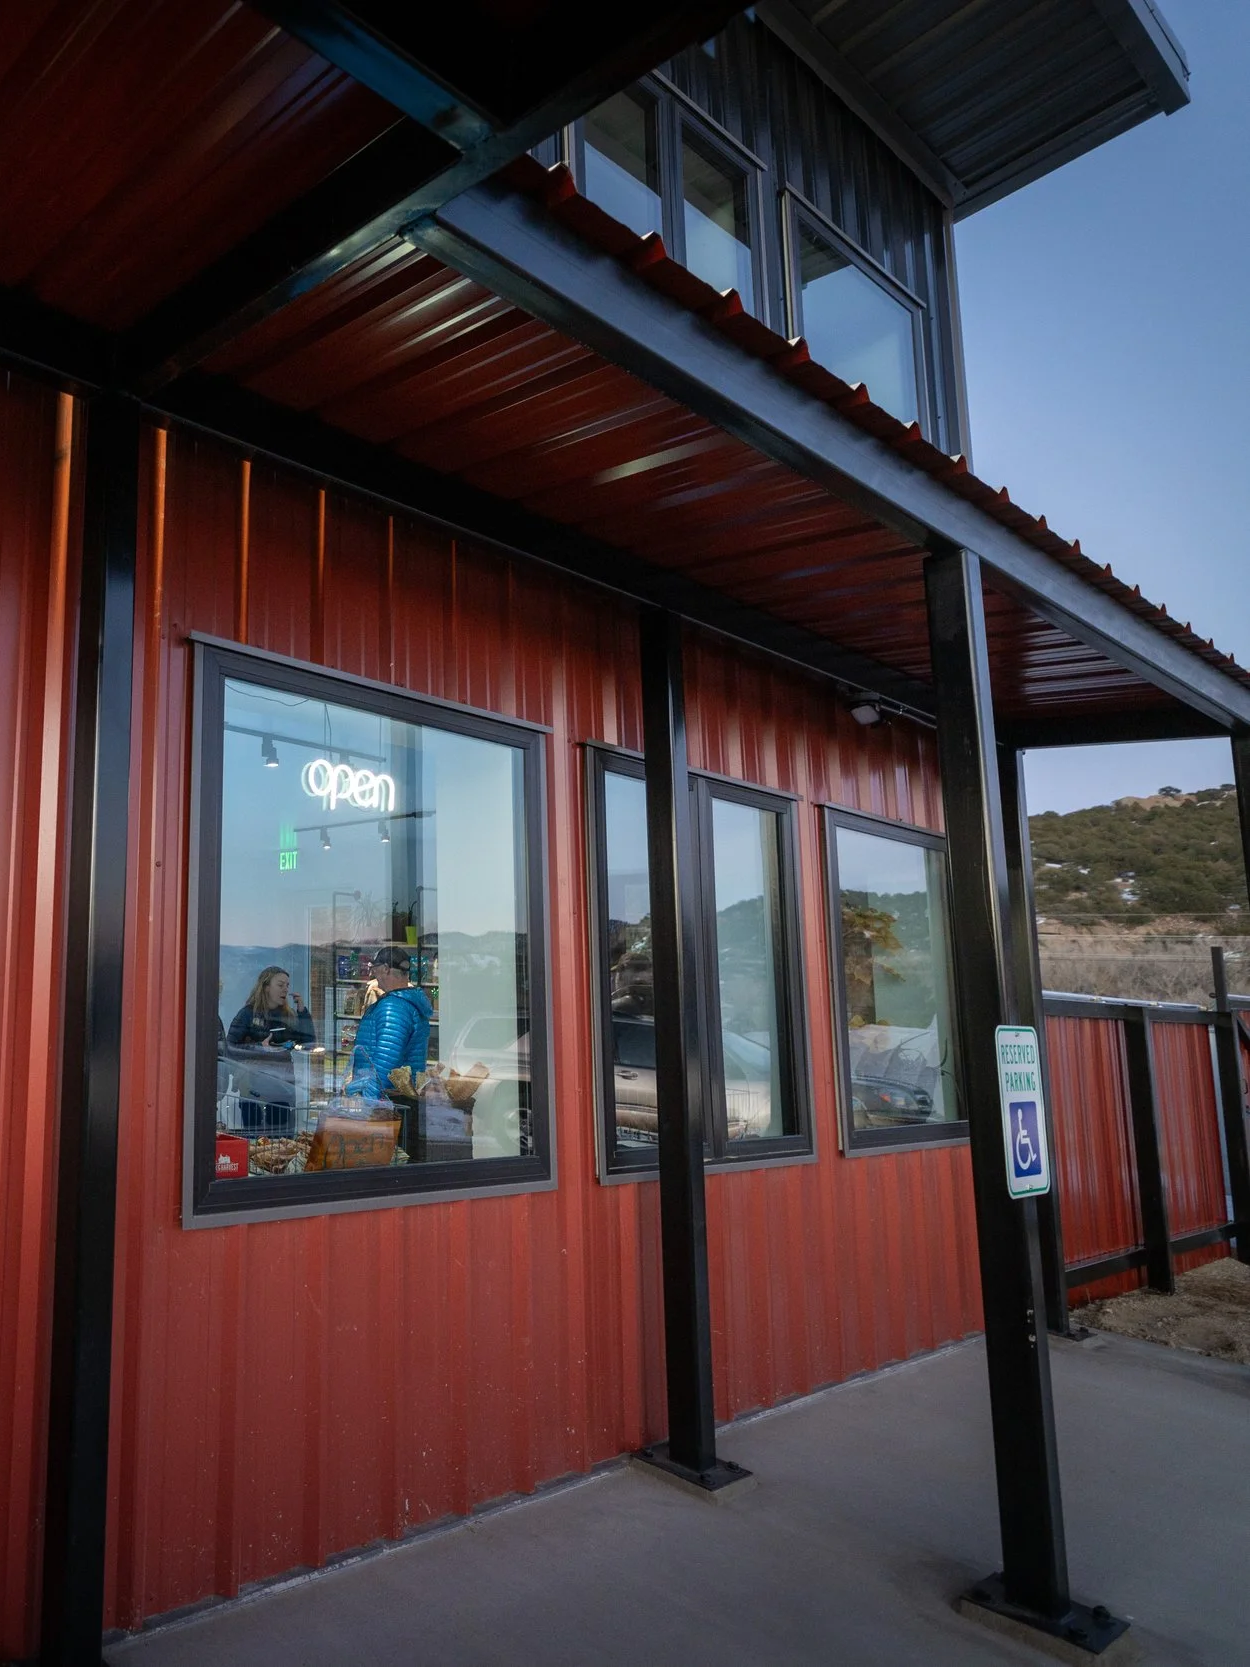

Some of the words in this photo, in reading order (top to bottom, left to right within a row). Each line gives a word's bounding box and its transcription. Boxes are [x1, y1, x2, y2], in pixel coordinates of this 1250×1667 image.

[305, 758, 395, 811] open
[280, 851, 298, 870] EXIT
[1000, 1045, 1035, 1064] RESERVED
[1004, 1072, 1036, 1091] PARKING
